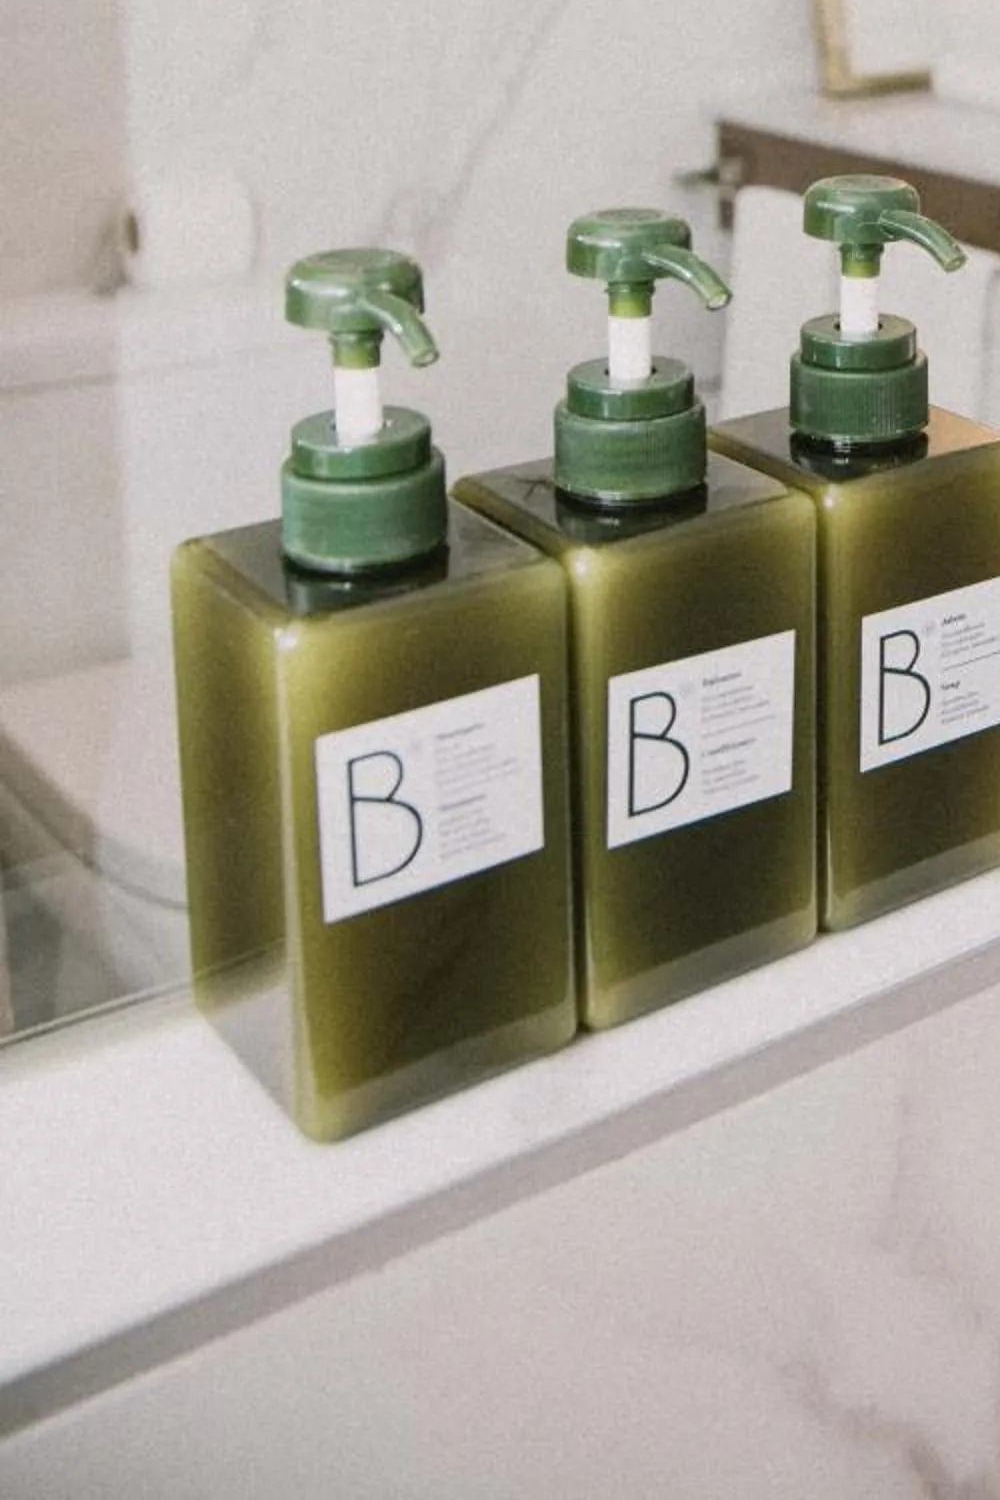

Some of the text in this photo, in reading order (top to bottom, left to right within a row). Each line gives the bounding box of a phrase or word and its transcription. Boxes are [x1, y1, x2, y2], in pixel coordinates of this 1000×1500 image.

[878, 629, 931, 745] B
[628, 691, 690, 817] B
[347, 750, 423, 888] B
